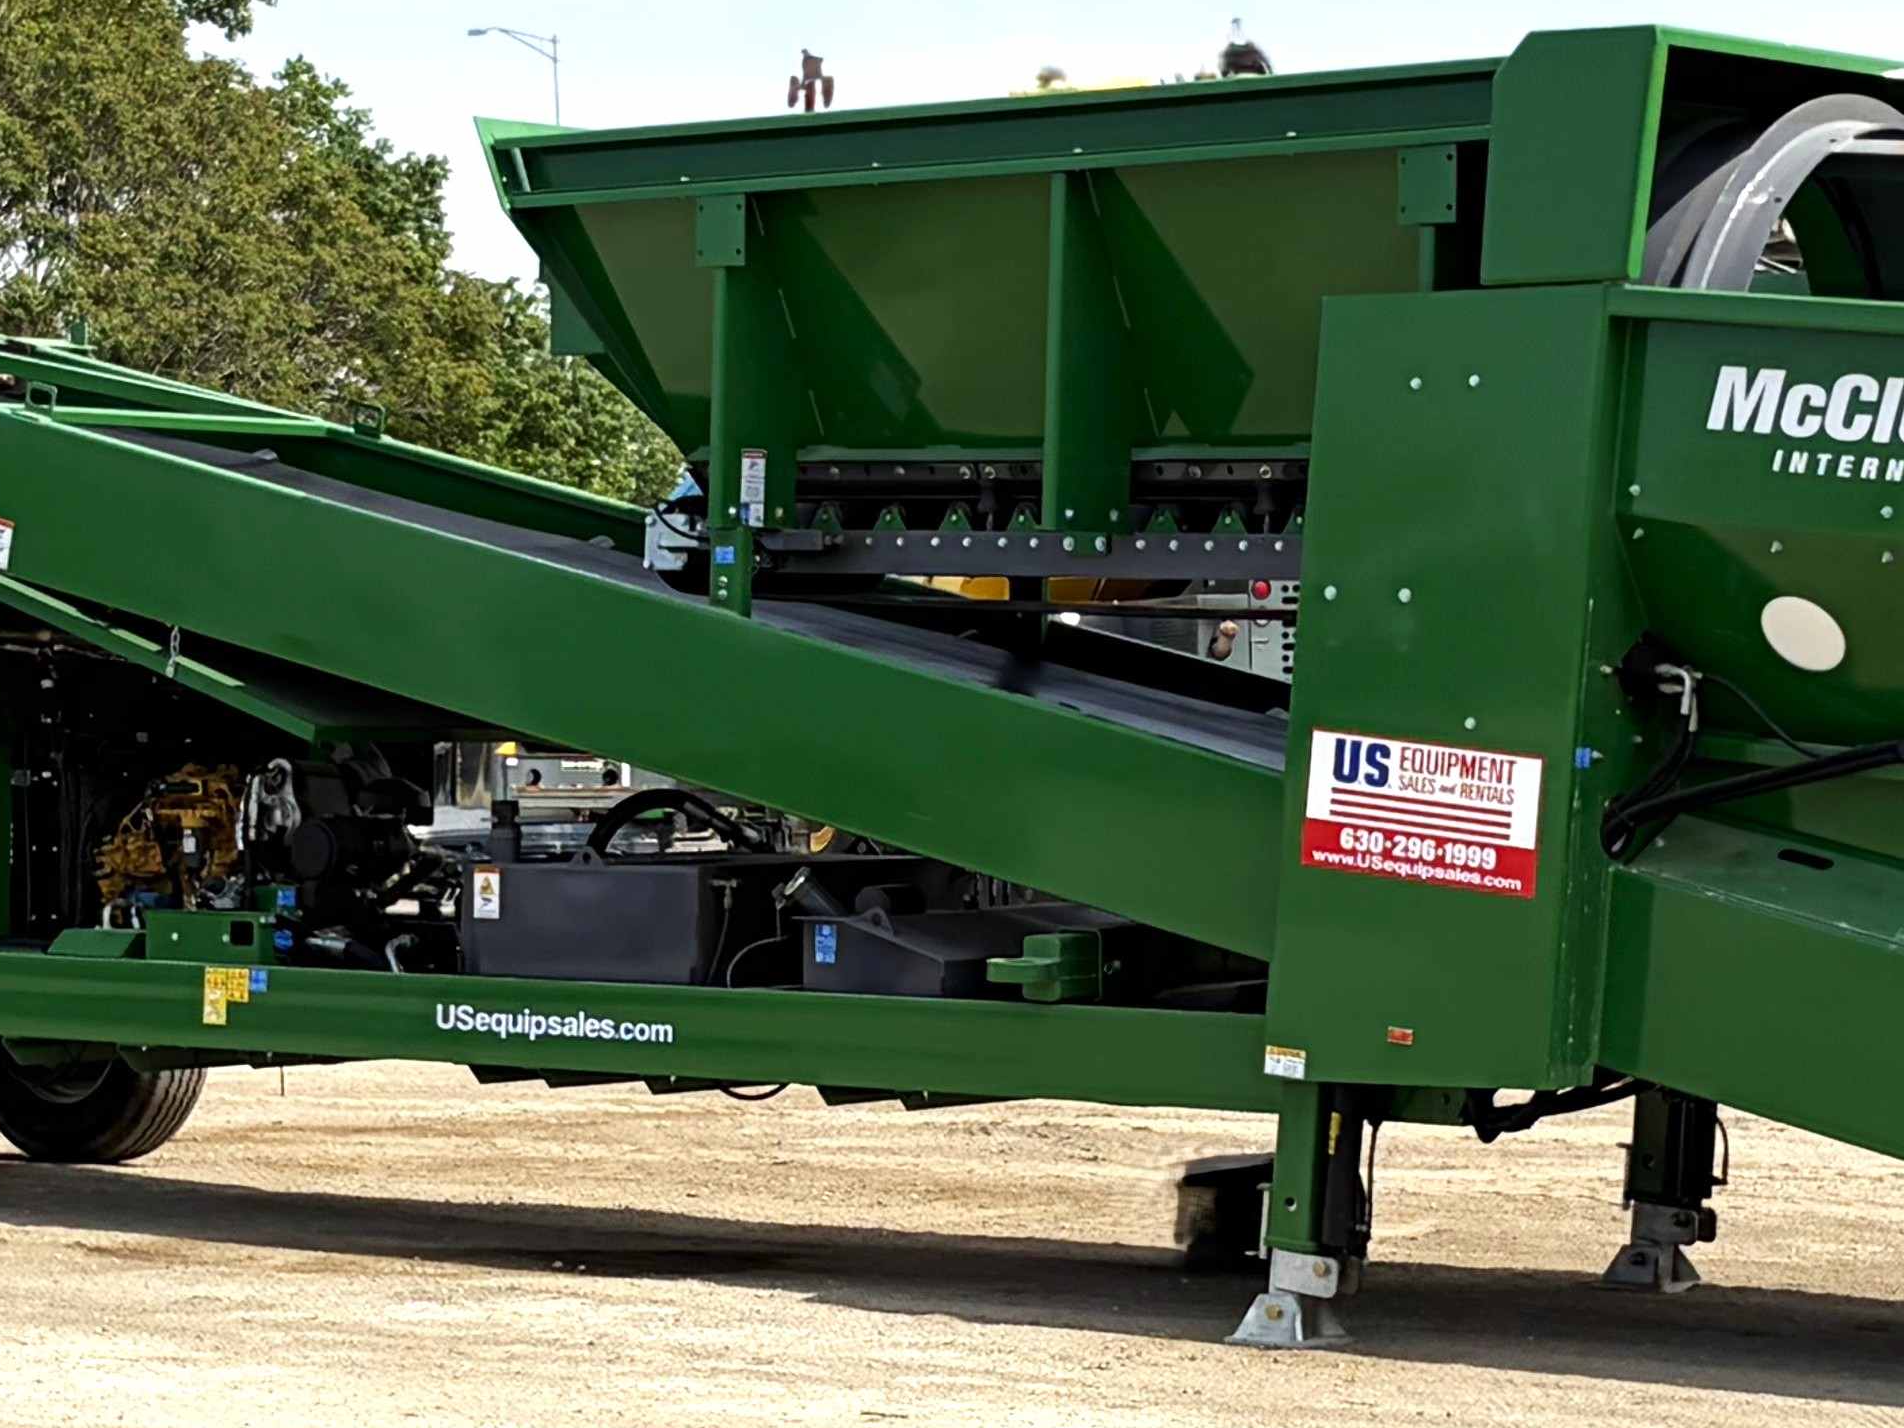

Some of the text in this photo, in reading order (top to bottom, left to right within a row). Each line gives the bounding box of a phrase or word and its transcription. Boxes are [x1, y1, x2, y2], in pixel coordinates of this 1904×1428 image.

[1399, 746, 1517, 785] EQUIPMENT
[1398, 775, 1515, 805] SALES and RENTALS
[1312, 850, 1522, 890] www.USequipsales.com
[436, 1004, 673, 1042] USequipsales.com
